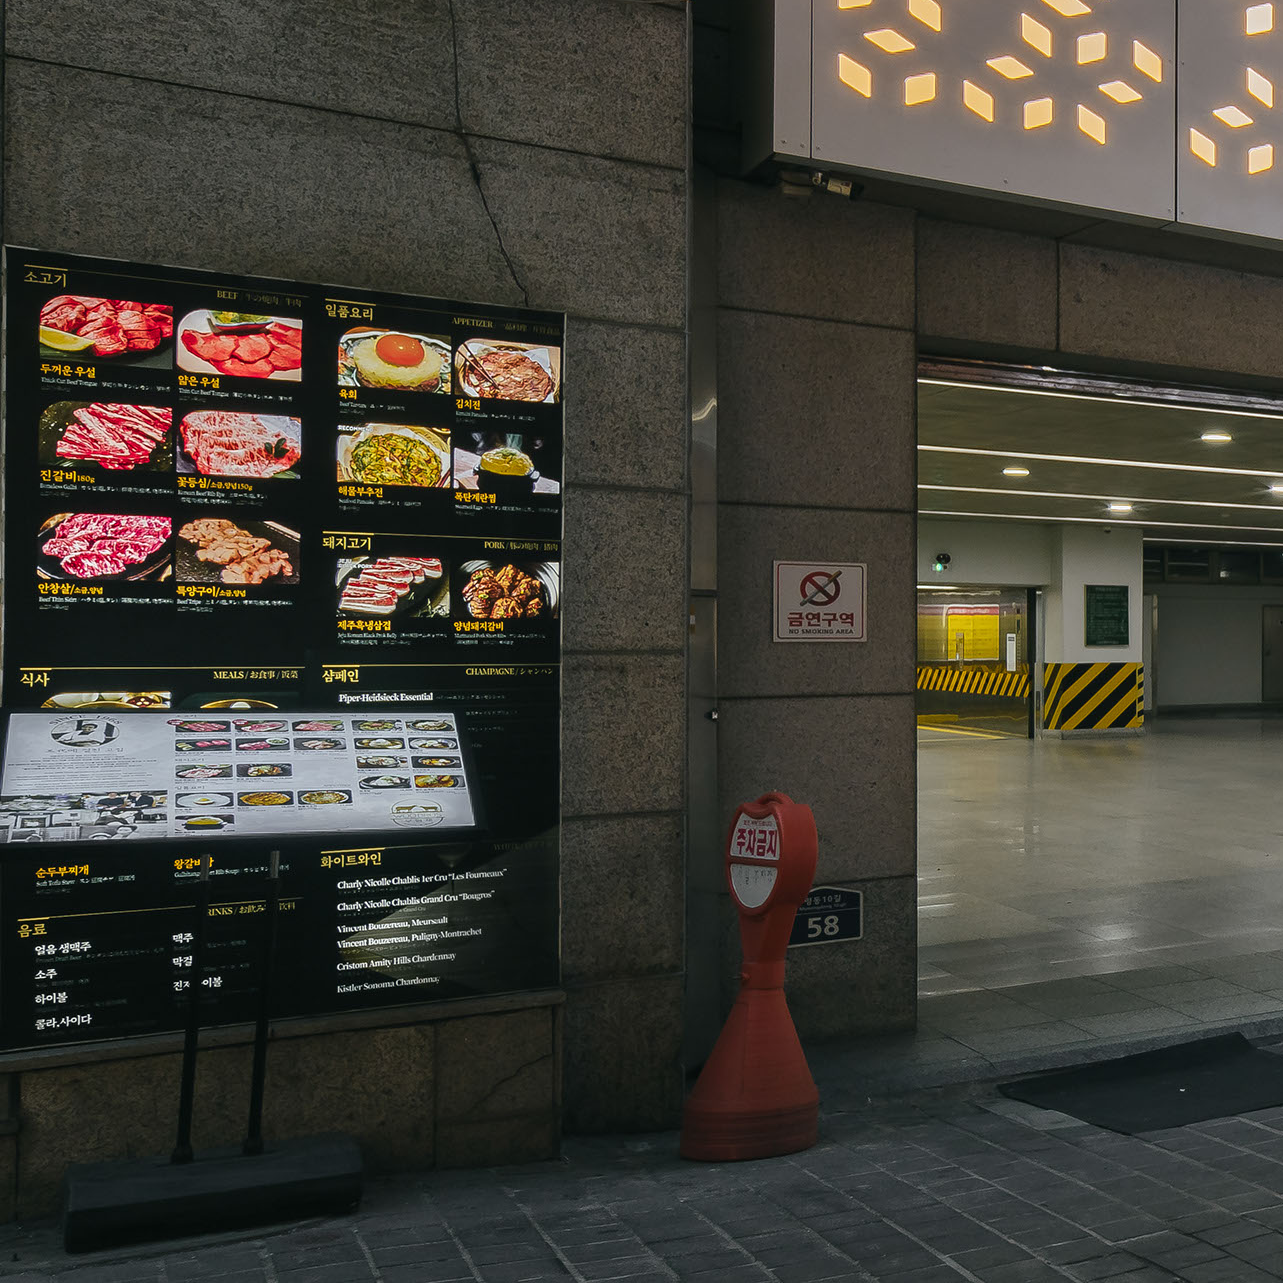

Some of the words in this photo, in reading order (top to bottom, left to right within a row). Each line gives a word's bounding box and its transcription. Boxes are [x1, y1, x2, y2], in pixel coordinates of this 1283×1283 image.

[23, 271, 68, 288] 소고기
[216, 290, 239, 300] BEEF
[325, 303, 374, 321] 일품요리
[451, 316, 493, 328] APPETIZER
[40, 363, 72, 377] 두꺼운
[75, 365, 97, 379] 우설
[178, 374, 198, 387] 얇은
[199, 376, 220, 389] 우설
[338, 388, 357, 400] 육회
[455, 398, 481, 411] 김치전
[338, 485, 383, 498] 해물부추전
[454, 491, 497, 504] 폭탄계란찜
[322, 535, 371, 551] 돼지고기
[484, 540, 505, 550] PORK
[453, 620, 504, 632] 양념돼지갈비
[787, 611, 854, 627] 금연구역
[213, 671, 244, 680] MEALS
[321, 669, 360, 683] 샴페인
[465, 667, 515, 676] CHAMPAGNE
[20, 672, 50, 688] 식사
[338, 693, 400, 704] Piper-Heidsieck
[400, 692, 433, 702] Essential
[736, 827, 778, 858] 주차금지
[320, 852, 382, 869] 화이트와인
[35, 864, 90, 878] 순두부찌개
[336, 879, 363, 890] Charly
[364, 877, 391, 888] Nicolle
[391, 875, 420, 886] Chablis
[434, 873, 448, 883] Cru
[336, 901, 363, 913] Charly
[364, 899, 391, 910] Nicolle
[391, 897, 420, 908] Chablis
[421, 894, 443, 905] Grand
[444, 894, 458, 904] Cru
[206, 906, 233, 916] RINKS
[17, 923, 48, 938] 음료
[336, 924, 367, 934] Vincent
[411, 916, 448, 927] Meursault
[807, 915, 840, 938] 58
[172, 932, 194, 944] 맥주
[336, 939, 367, 949] Vincent
[411, 928, 482, 944] Puligny-Montrachet
[34, 943, 59, 955] 얼음
[59, 941, 92, 954] 생맥주
[172, 955, 193, 967] 막걸
[336, 961, 368, 971] Cristom
[368, 957, 392, 969] Amity
[393, 956, 411, 965] Hills
[411, 951, 456, 964] Chardonnay
[34, 968, 58, 980] 소주
[336, 983, 362, 993] Kistler
[363, 980, 394, 990] Sonoma
[395, 975, 440, 986] Chardonnay
[34, 991, 68, 1005] 하이볼
